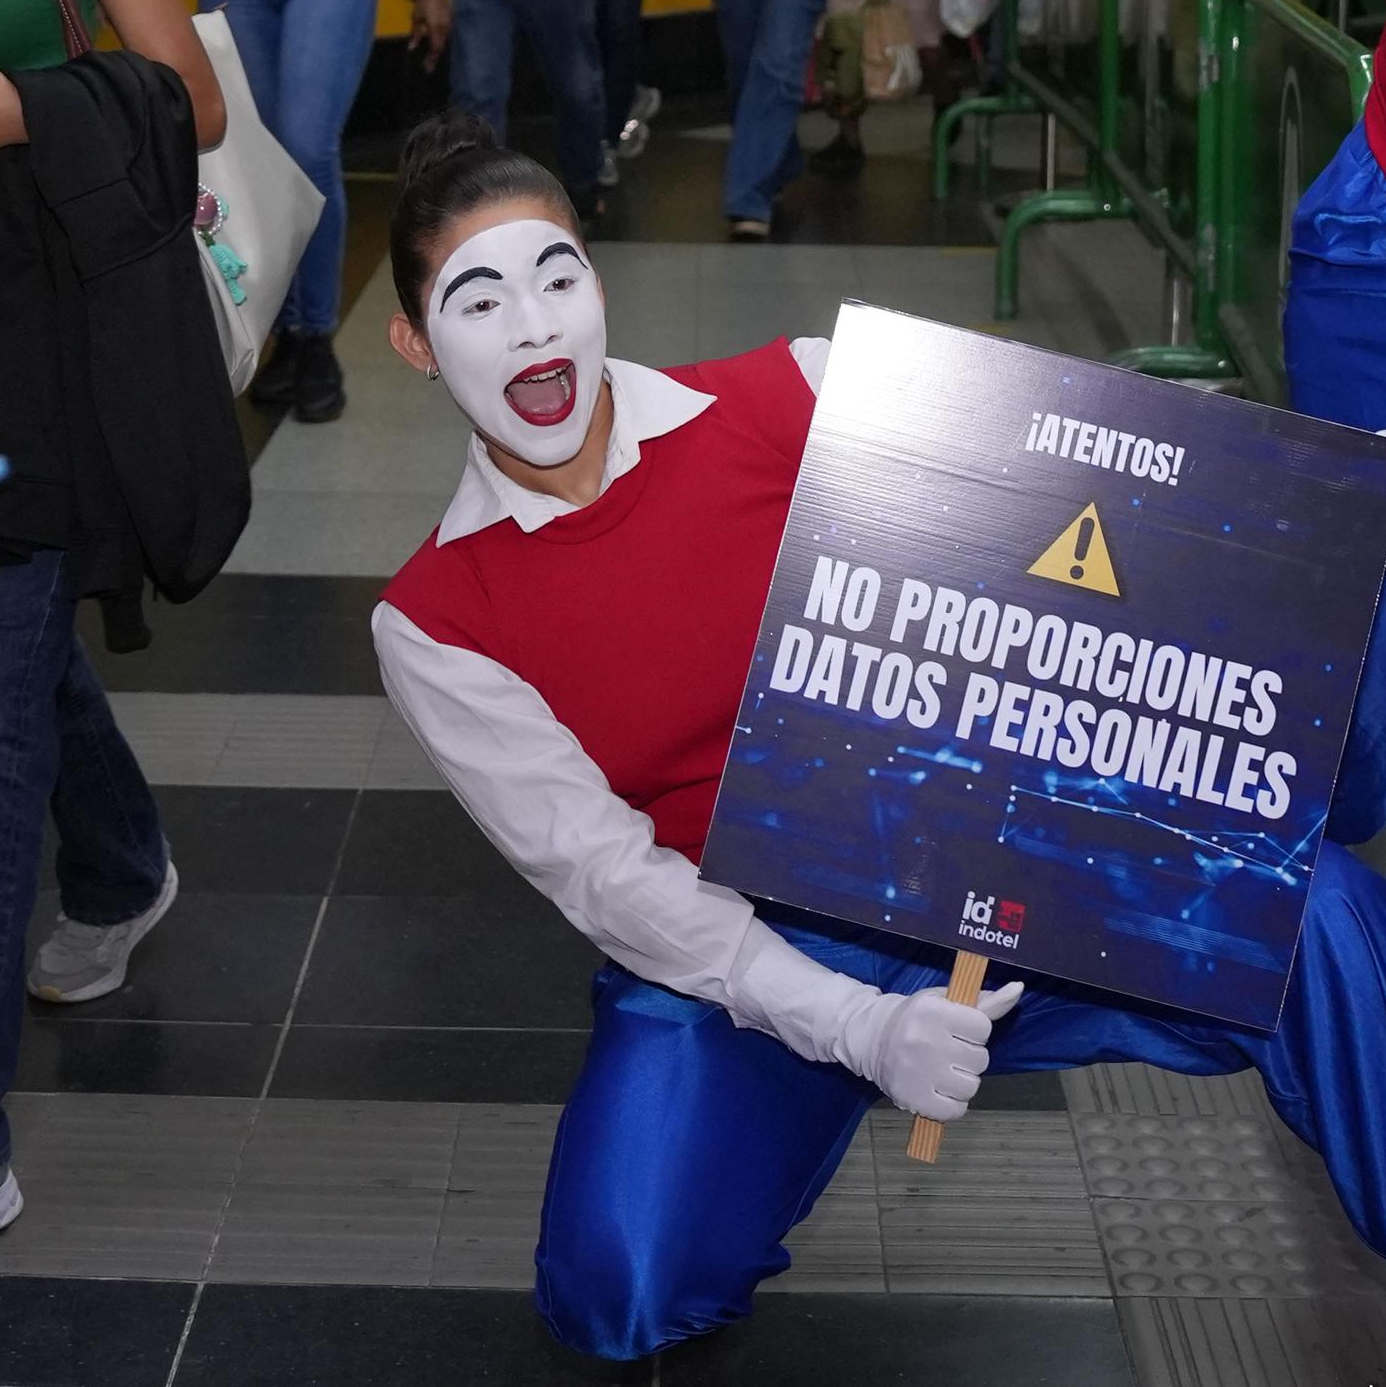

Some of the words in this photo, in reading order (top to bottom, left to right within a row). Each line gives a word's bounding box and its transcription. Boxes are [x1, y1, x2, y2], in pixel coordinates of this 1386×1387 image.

[1025, 412, 1186, 486] ¡ATENTOS!
[803, 556, 881, 631] NO
[892, 577, 1283, 737] PROPORCIONES
[770, 624, 948, 729] DATOS
[956, 678, 1298, 820] PERSONALES
[958, 920, 1019, 949] indotel
